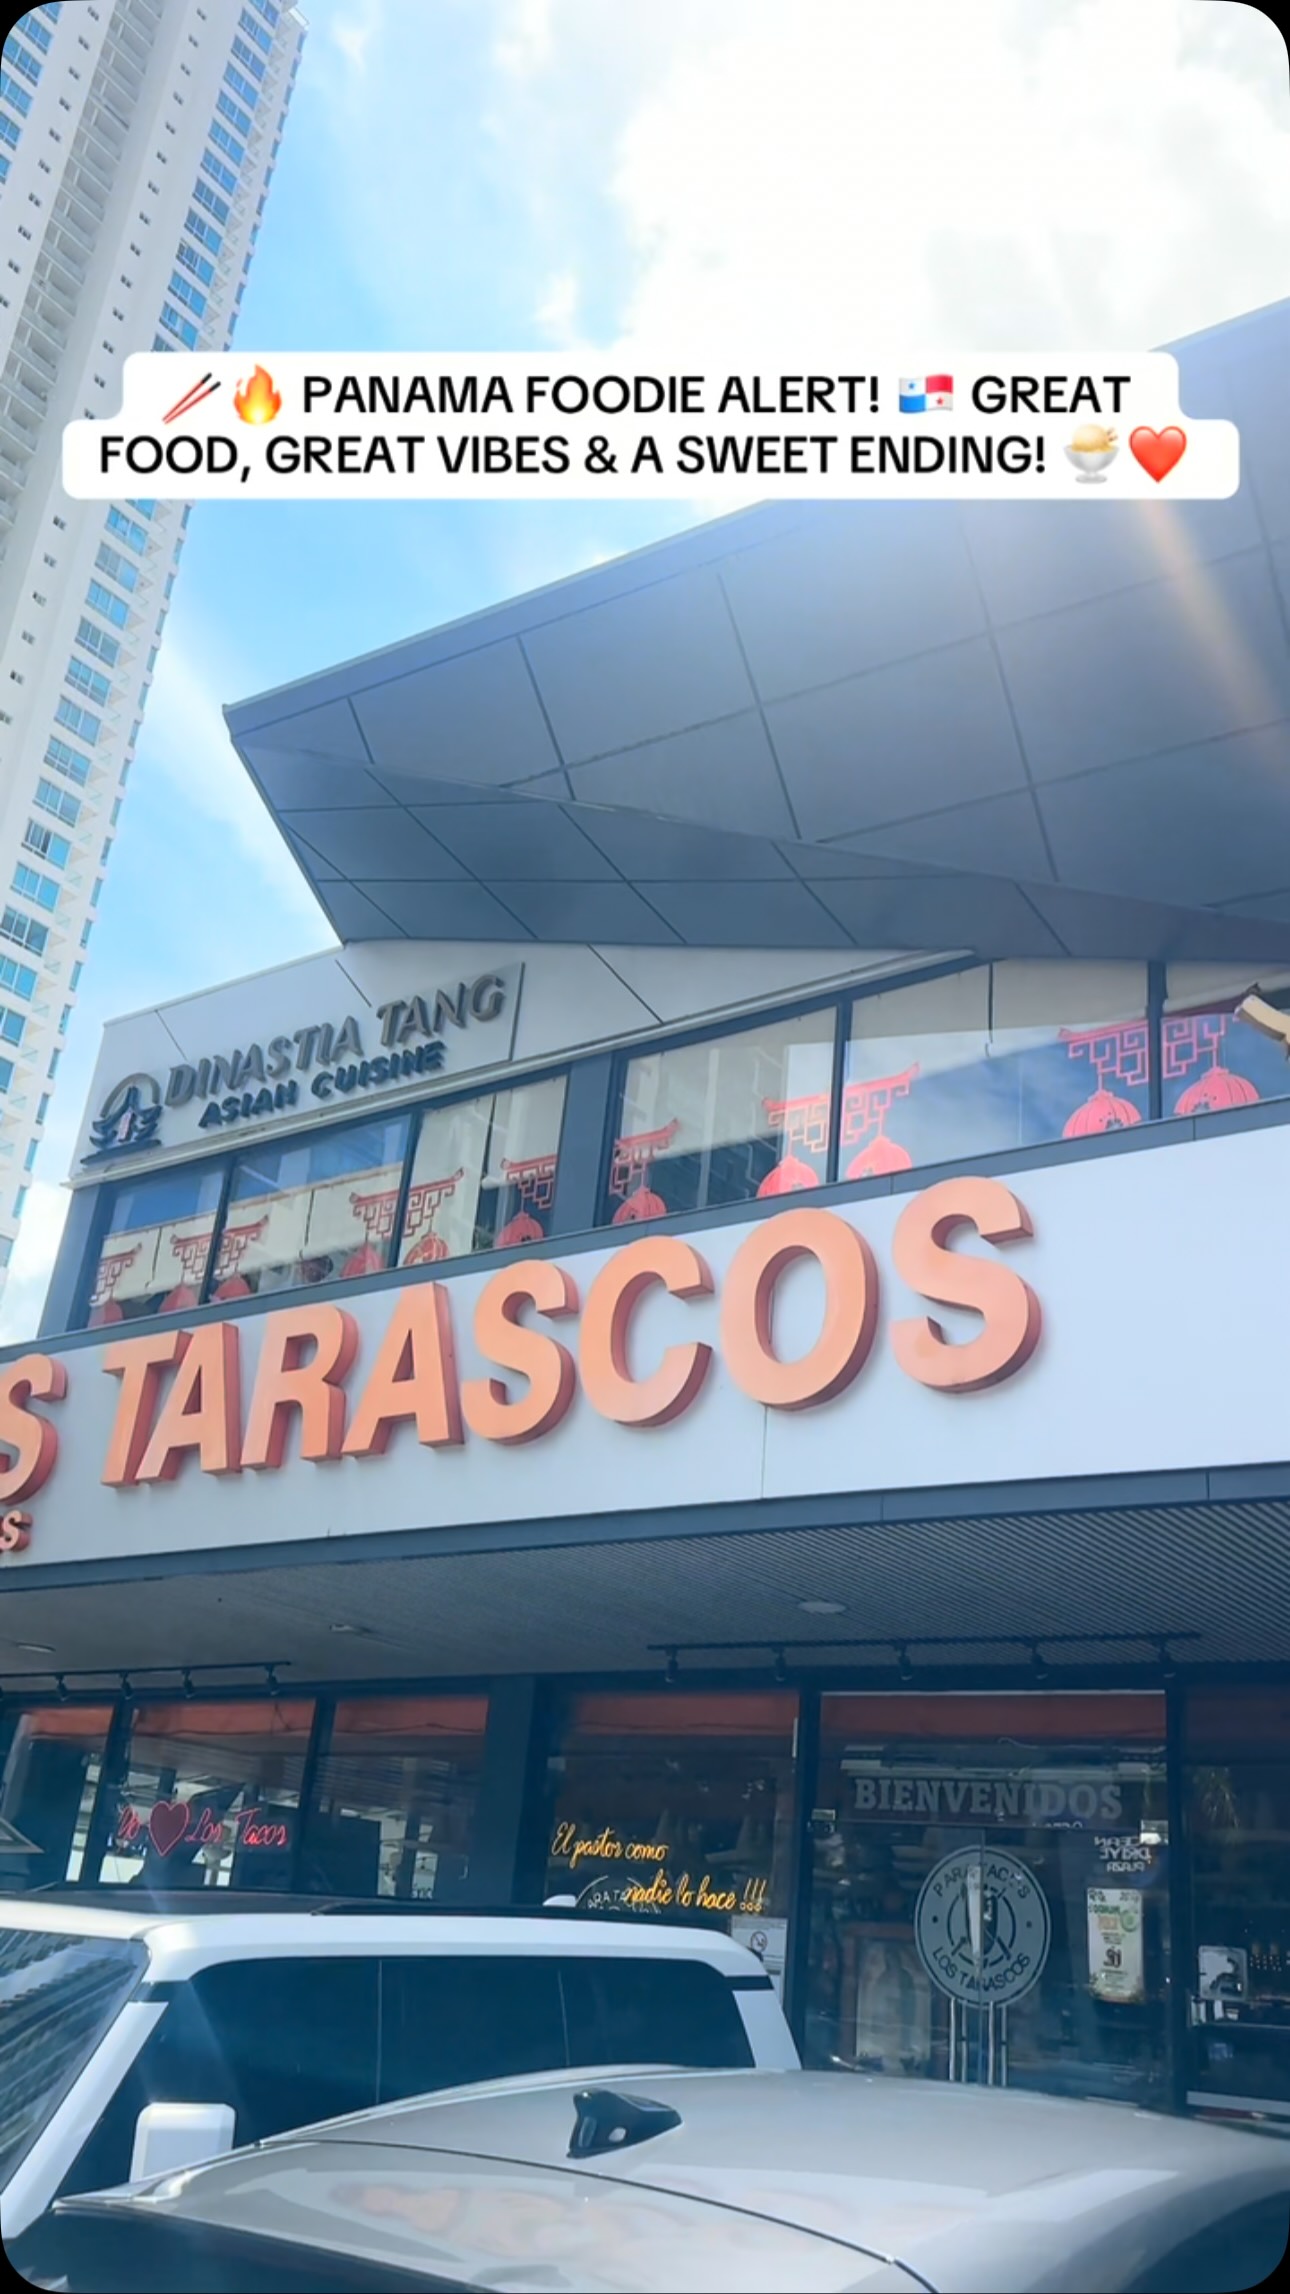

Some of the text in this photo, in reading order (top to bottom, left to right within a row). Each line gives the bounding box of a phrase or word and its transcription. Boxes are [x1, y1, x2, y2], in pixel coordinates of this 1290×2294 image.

[164, 973, 506, 1107] DINASTIA TANG
[198, 1040, 447, 1129] ASIAN CUISINE
[101, 1175, 1043, 1488] TARASCOS
[853, 1777, 1123, 1820] BIENVENIDOS
[185, 1807, 224, 1843] Los
[235, 1808, 289, 1846] Tacos
[552, 1822, 670, 1869] El pastor como
[624, 1868, 674, 1906] nadie
[675, 1873, 692, 1908] lo
[696, 1875, 737, 1910] hace
[932, 1946, 958, 1979] LOS
